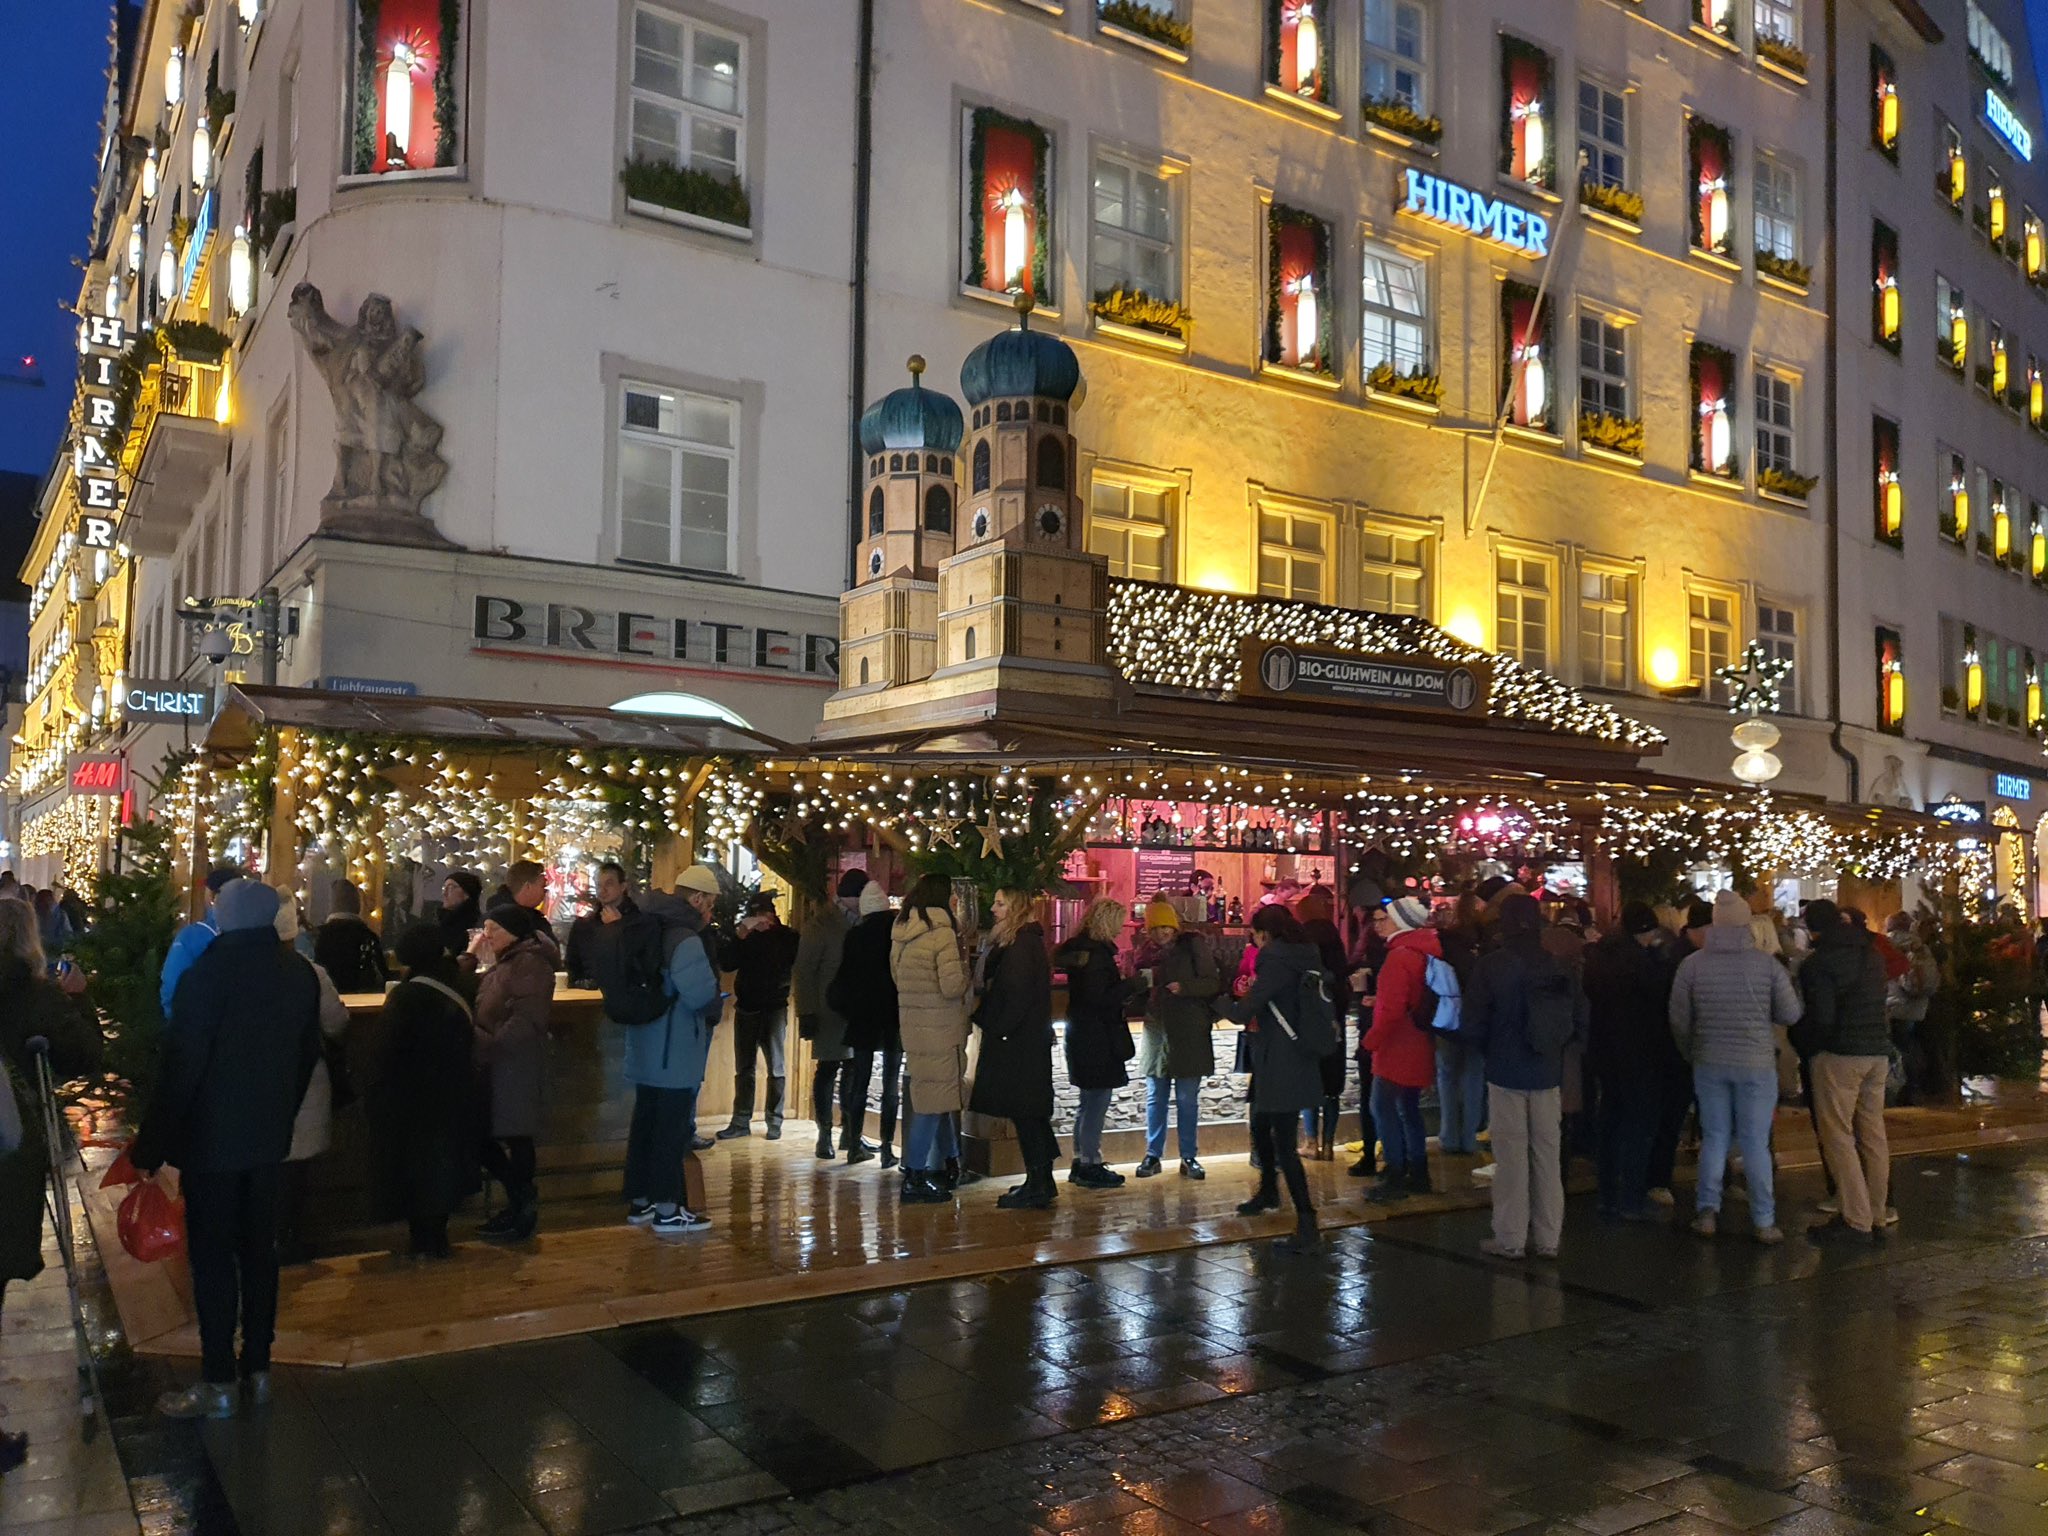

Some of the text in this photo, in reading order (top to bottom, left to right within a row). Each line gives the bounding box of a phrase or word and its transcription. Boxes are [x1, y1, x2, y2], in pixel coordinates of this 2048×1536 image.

[1986, 88, 2032, 162] HIRMER
[1405, 167, 1549, 257] HIRMER
[82, 315, 122, 548] HIRMER
[474, 594, 839, 677] BREITER
[1298, 660, 1444, 691] BIO-GLÜHWEIN AM DOM
[126, 689, 204, 715] CHRIST
[73, 761, 118, 788] H&M
[1997, 774, 2030, 800] HIRMER
